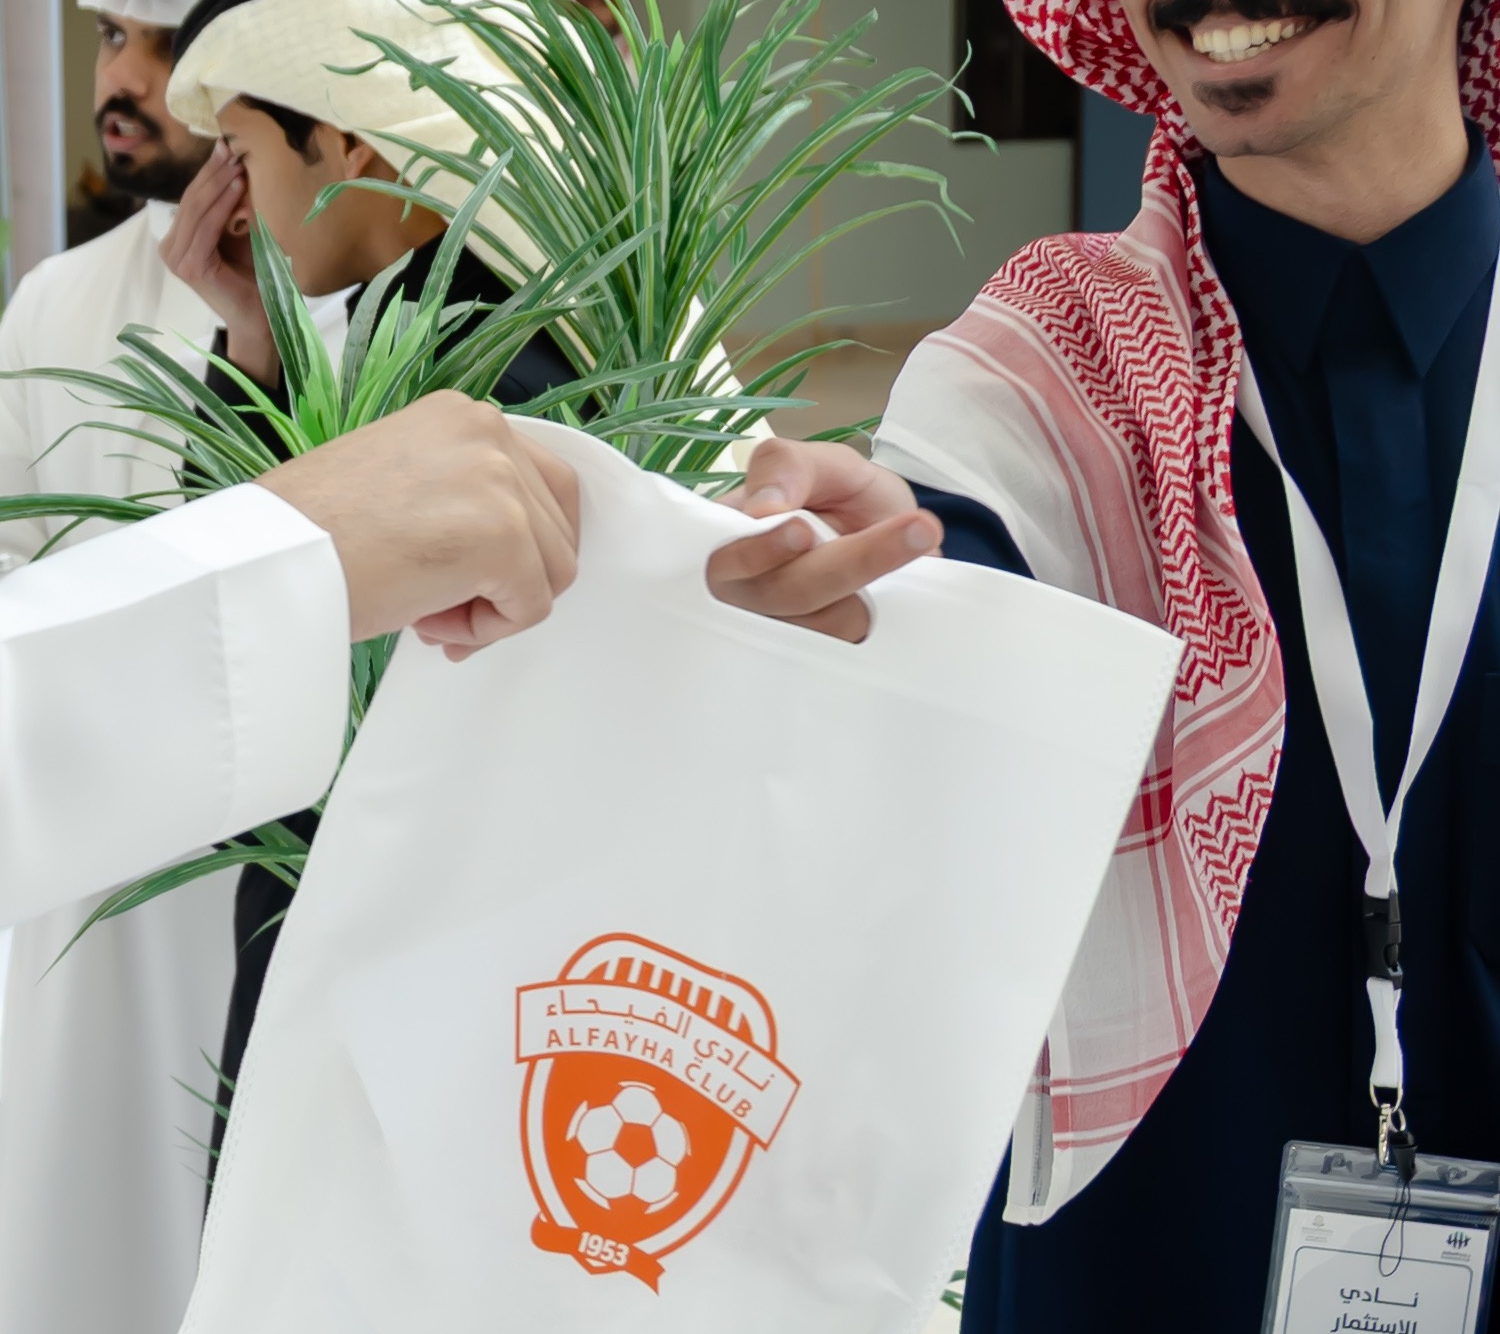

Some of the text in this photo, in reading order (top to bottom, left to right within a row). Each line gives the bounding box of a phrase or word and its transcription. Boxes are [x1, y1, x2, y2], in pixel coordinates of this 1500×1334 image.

[545, 989, 776, 1092] نادي الفيحاء
[546, 1028, 753, 1119] ALFAYHA CLUB
[577, 1231, 630, 1267] 1953
[1339, 1287, 1419, 1308] نادي
